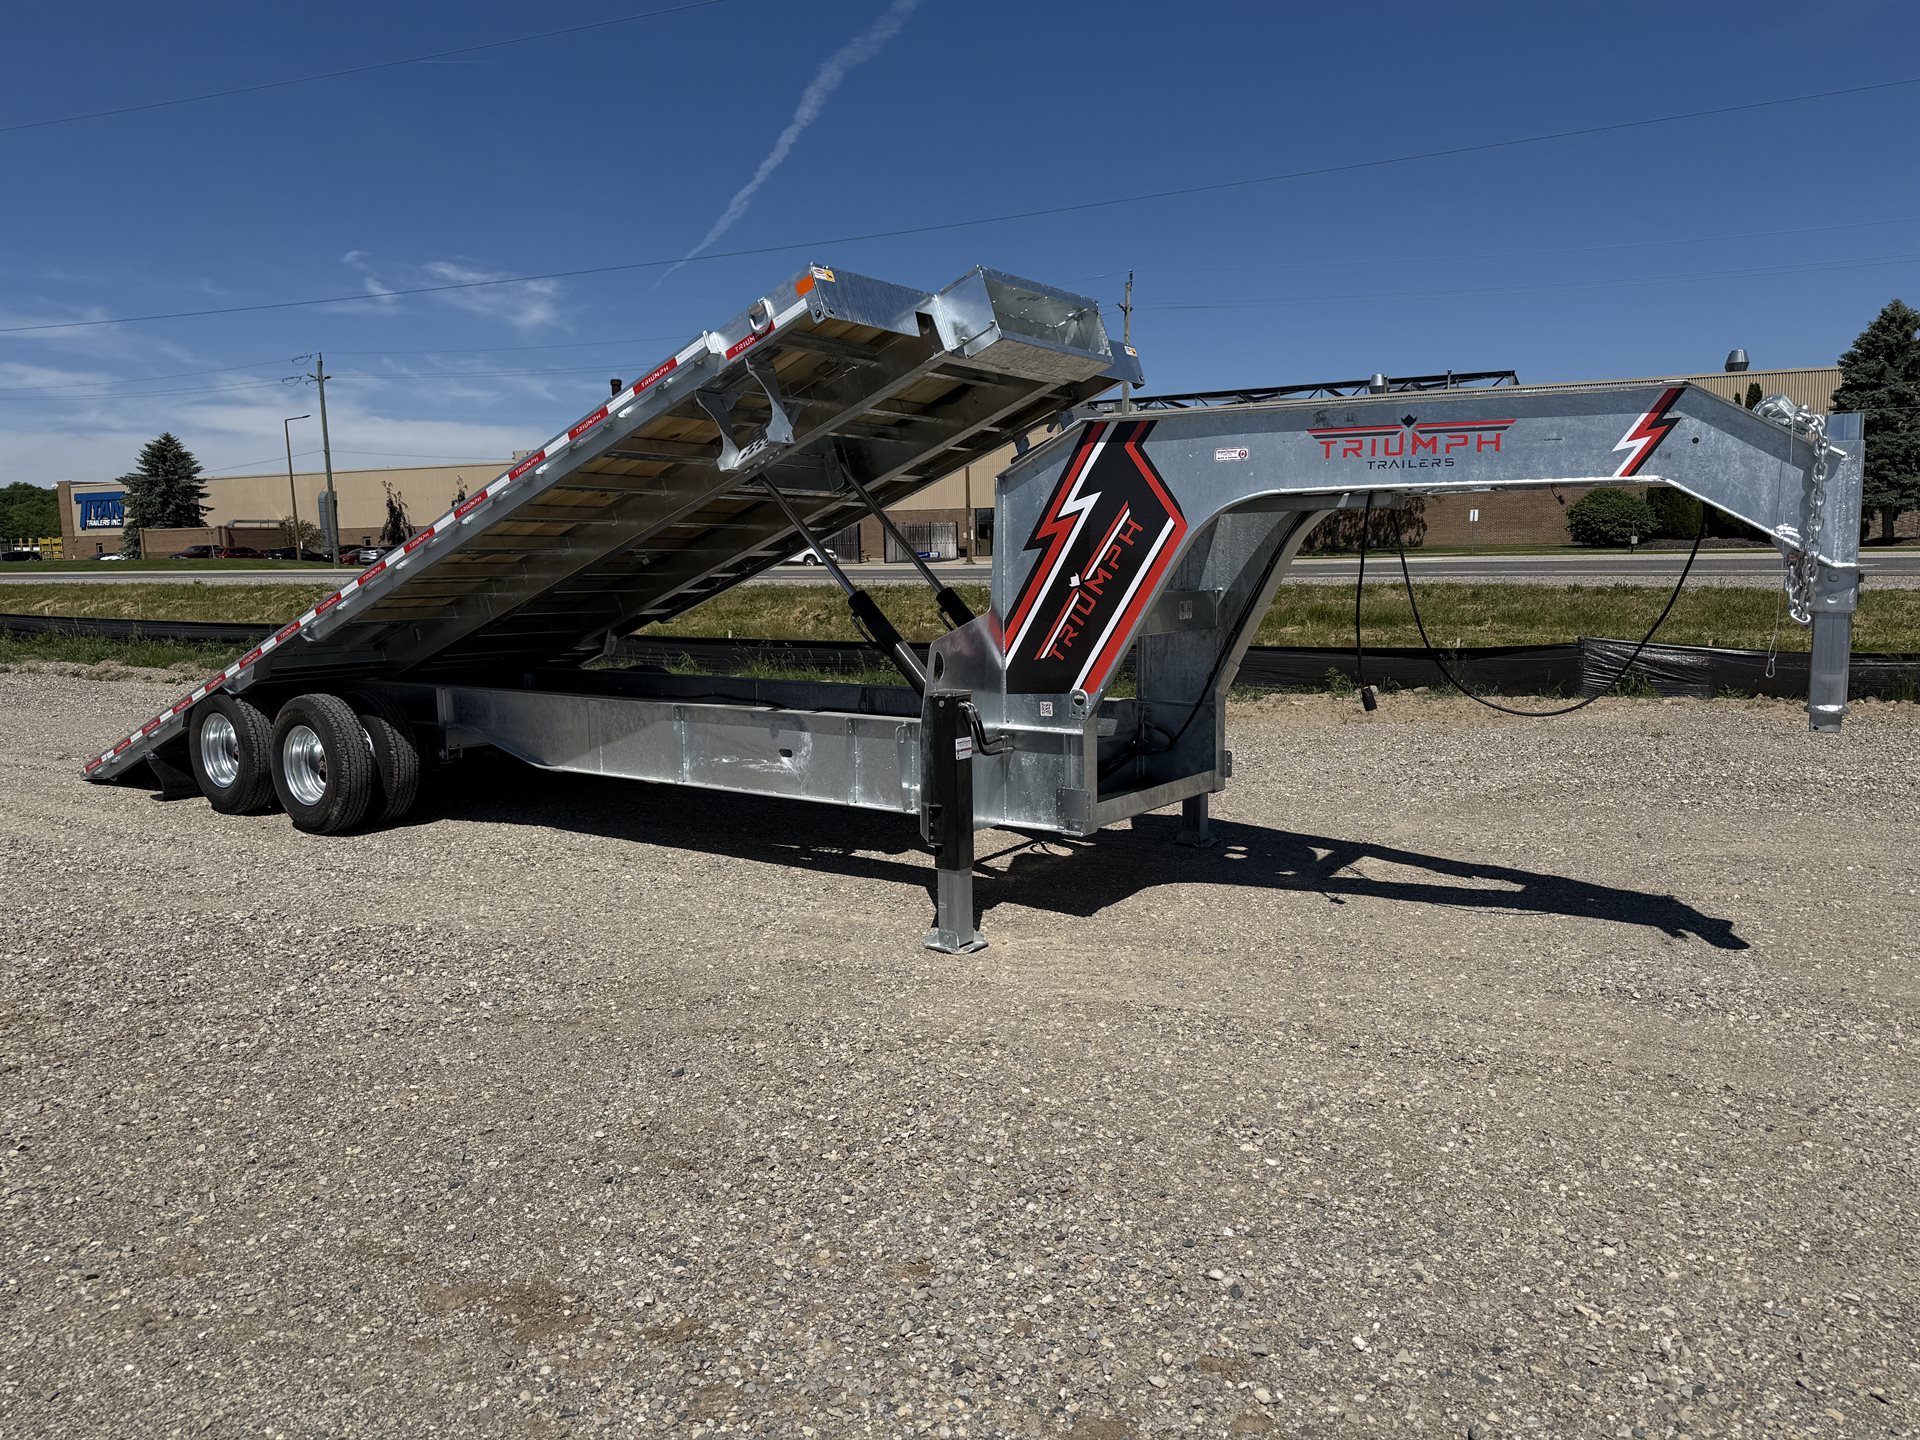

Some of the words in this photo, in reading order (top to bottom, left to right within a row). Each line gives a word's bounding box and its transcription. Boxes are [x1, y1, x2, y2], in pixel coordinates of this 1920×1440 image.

[641, 365, 669, 388] TRIUMPH
[575, 413, 601, 434] TRIUMPH
[1319, 432, 1502, 460] TRIUMPH
[1367, 457, 1455, 470] TRAILERS
[74, 491, 125, 531] TITAN
[86, 519, 110, 527] TRAILERS
[1048, 517, 1143, 661] TRIUMPH
